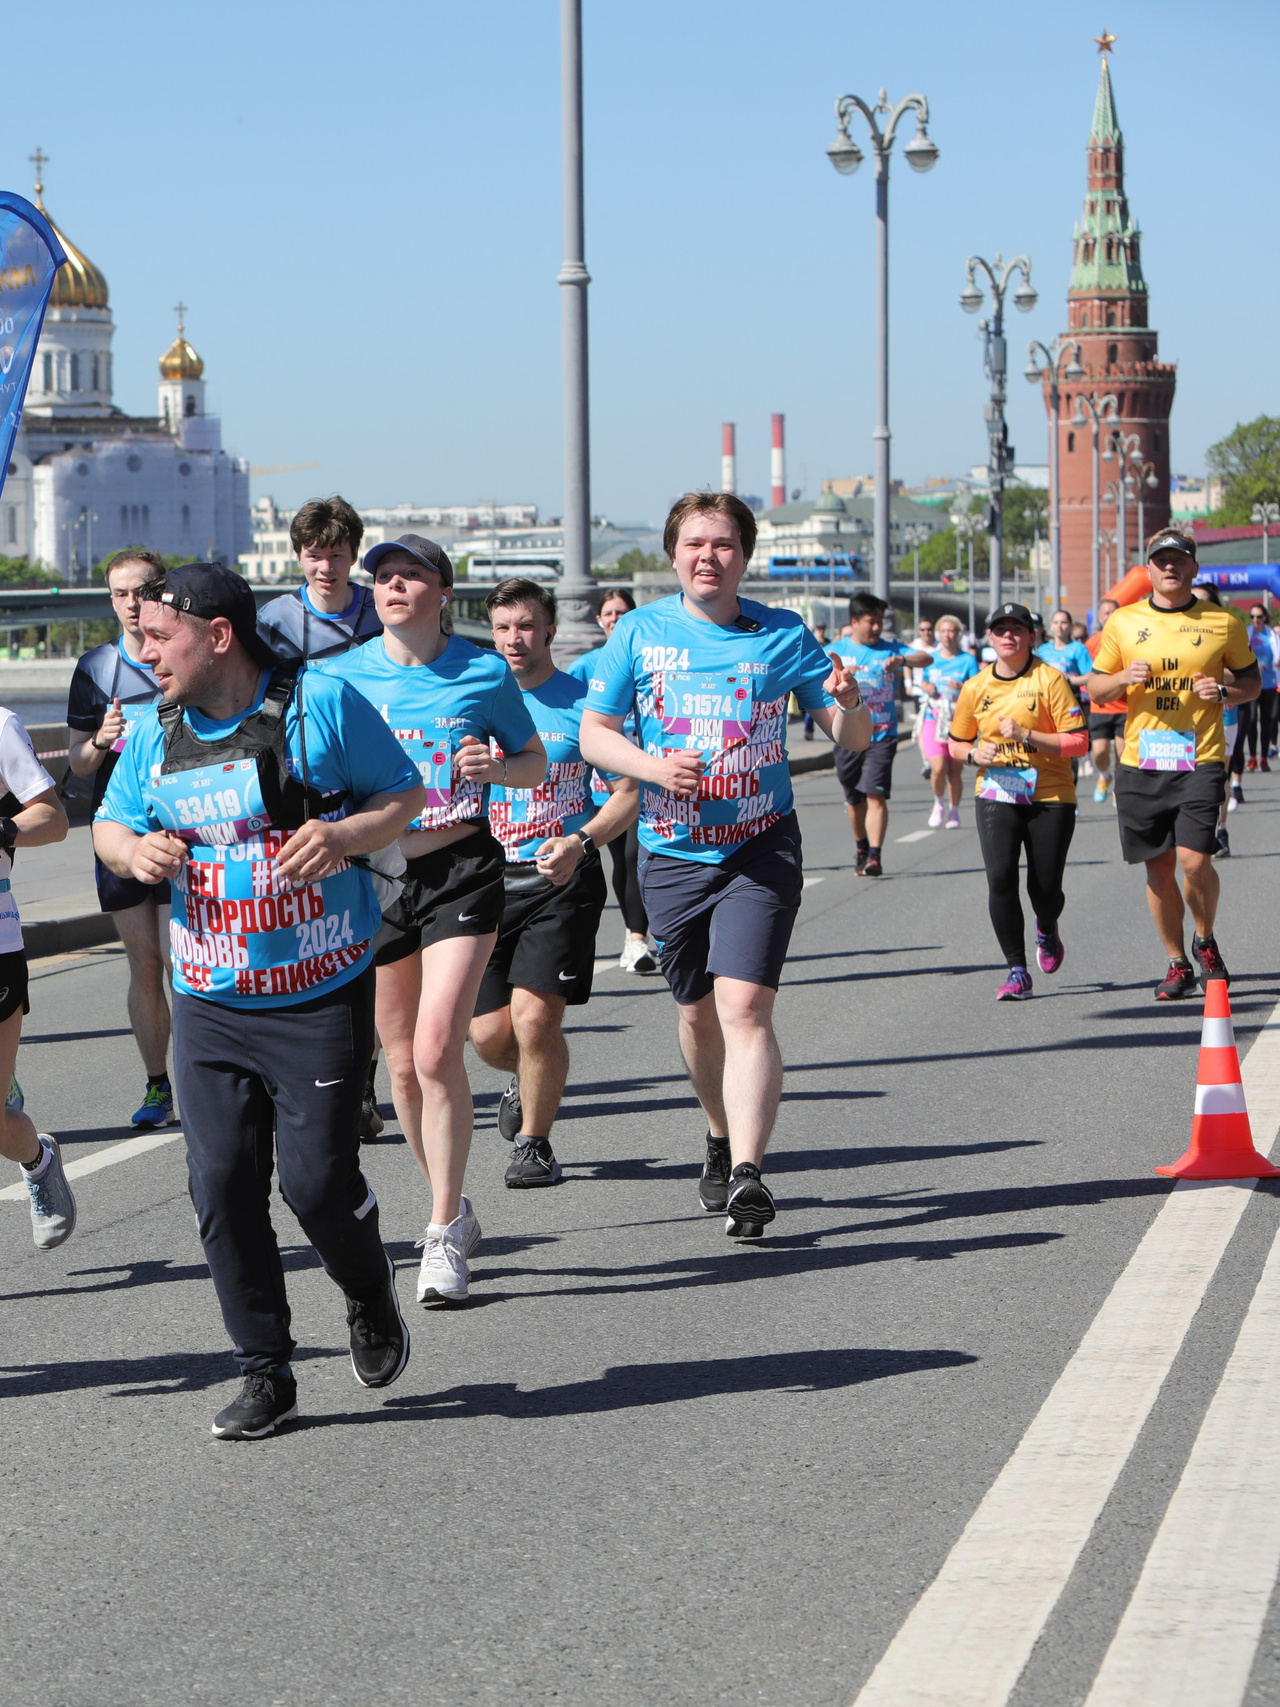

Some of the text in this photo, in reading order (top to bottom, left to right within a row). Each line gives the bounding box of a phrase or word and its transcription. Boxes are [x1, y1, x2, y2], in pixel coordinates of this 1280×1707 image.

[641, 646, 691, 672] 2024
[1161, 657, 1179, 671] ТЫ
[588, 678, 606, 693] ПСБ
[738, 690, 745, 699] E
[681, 693, 733, 718] 31574
[1156, 696, 1180, 711] ВСЕ!
[689, 718, 724, 737] 10КМ
[435, 754, 443, 763] E
[709, 741, 785, 776] #МОМЕНТ
[1148, 743, 1185, 758] 32825
[285, 757, 299, 773] ЕГ
[161, 777, 179, 786] ПСБ
[174, 788, 242, 826] 33419
[526, 796, 586, 822] #МОМЕНТ
[736, 791, 774, 823] 2024
[195, 821, 240, 845] 10КМ
[251, 819, 261, 830] D
[186, 882, 326, 934] #ГОРДОСТЬ
[296, 909, 355, 960] 2024
